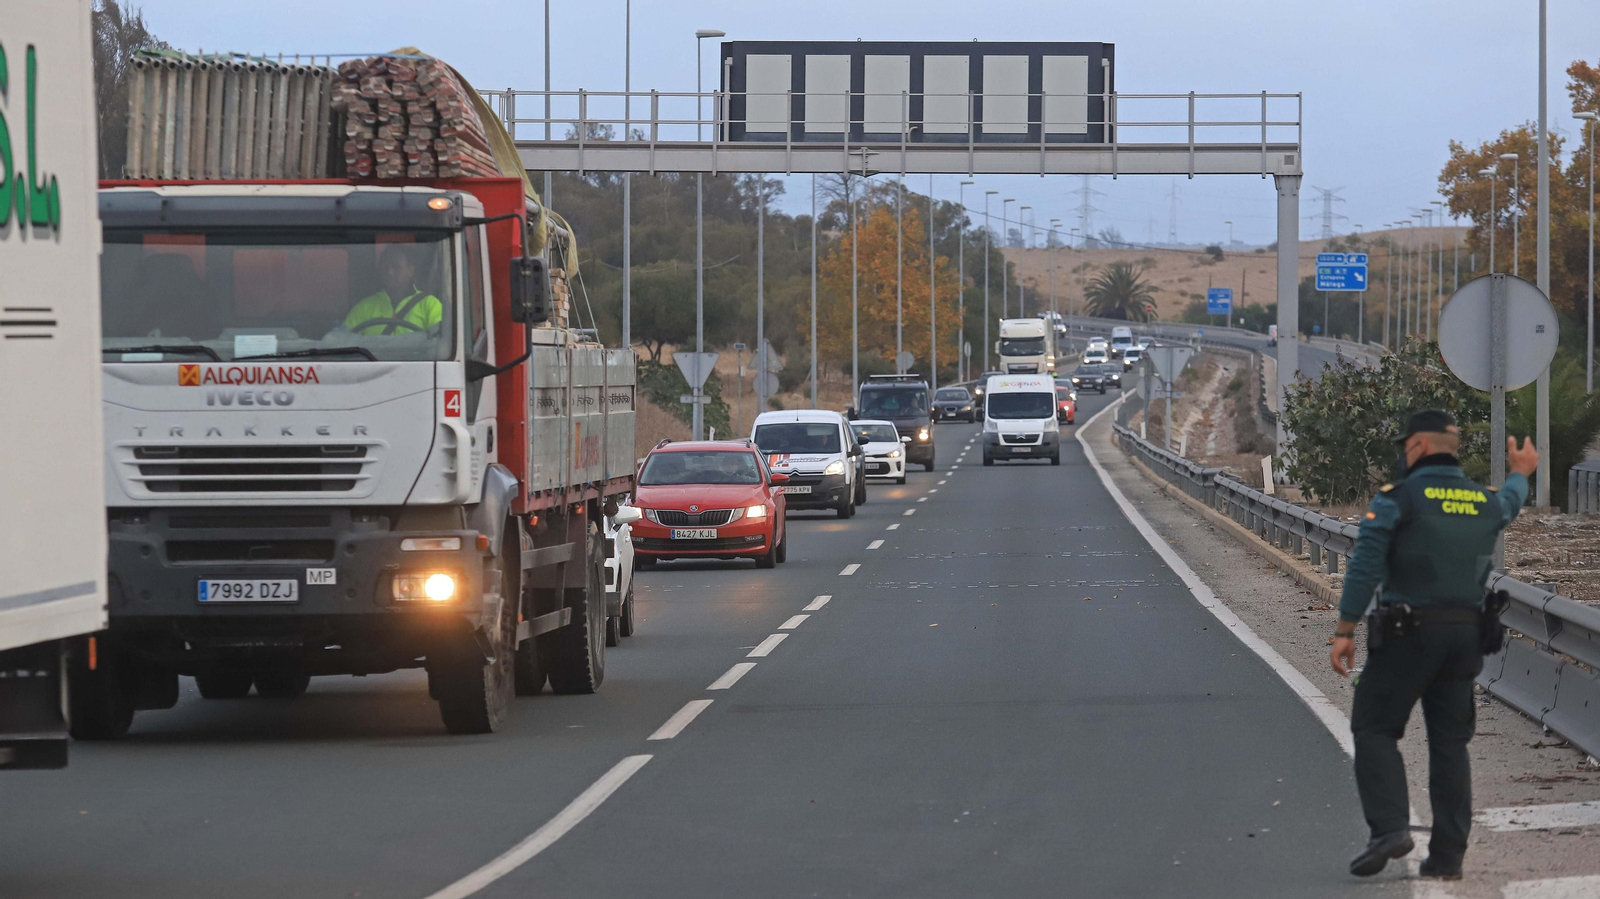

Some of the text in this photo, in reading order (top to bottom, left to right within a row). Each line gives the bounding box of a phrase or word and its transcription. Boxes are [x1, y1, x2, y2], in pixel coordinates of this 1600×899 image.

[203, 366, 320, 386] ALQUIANSA
[206, 390, 295, 406] IVECO
[446, 393, 460, 414] 4
[133, 425, 368, 437] TRAKKER
[1424, 487, 1488, 503] GUARDIA
[1442, 500, 1479, 515] CIVIL
[676, 530, 715, 538] 8427 KJL
[309, 570, 333, 583] MP
[210, 583, 294, 599] 7992 DZJ
